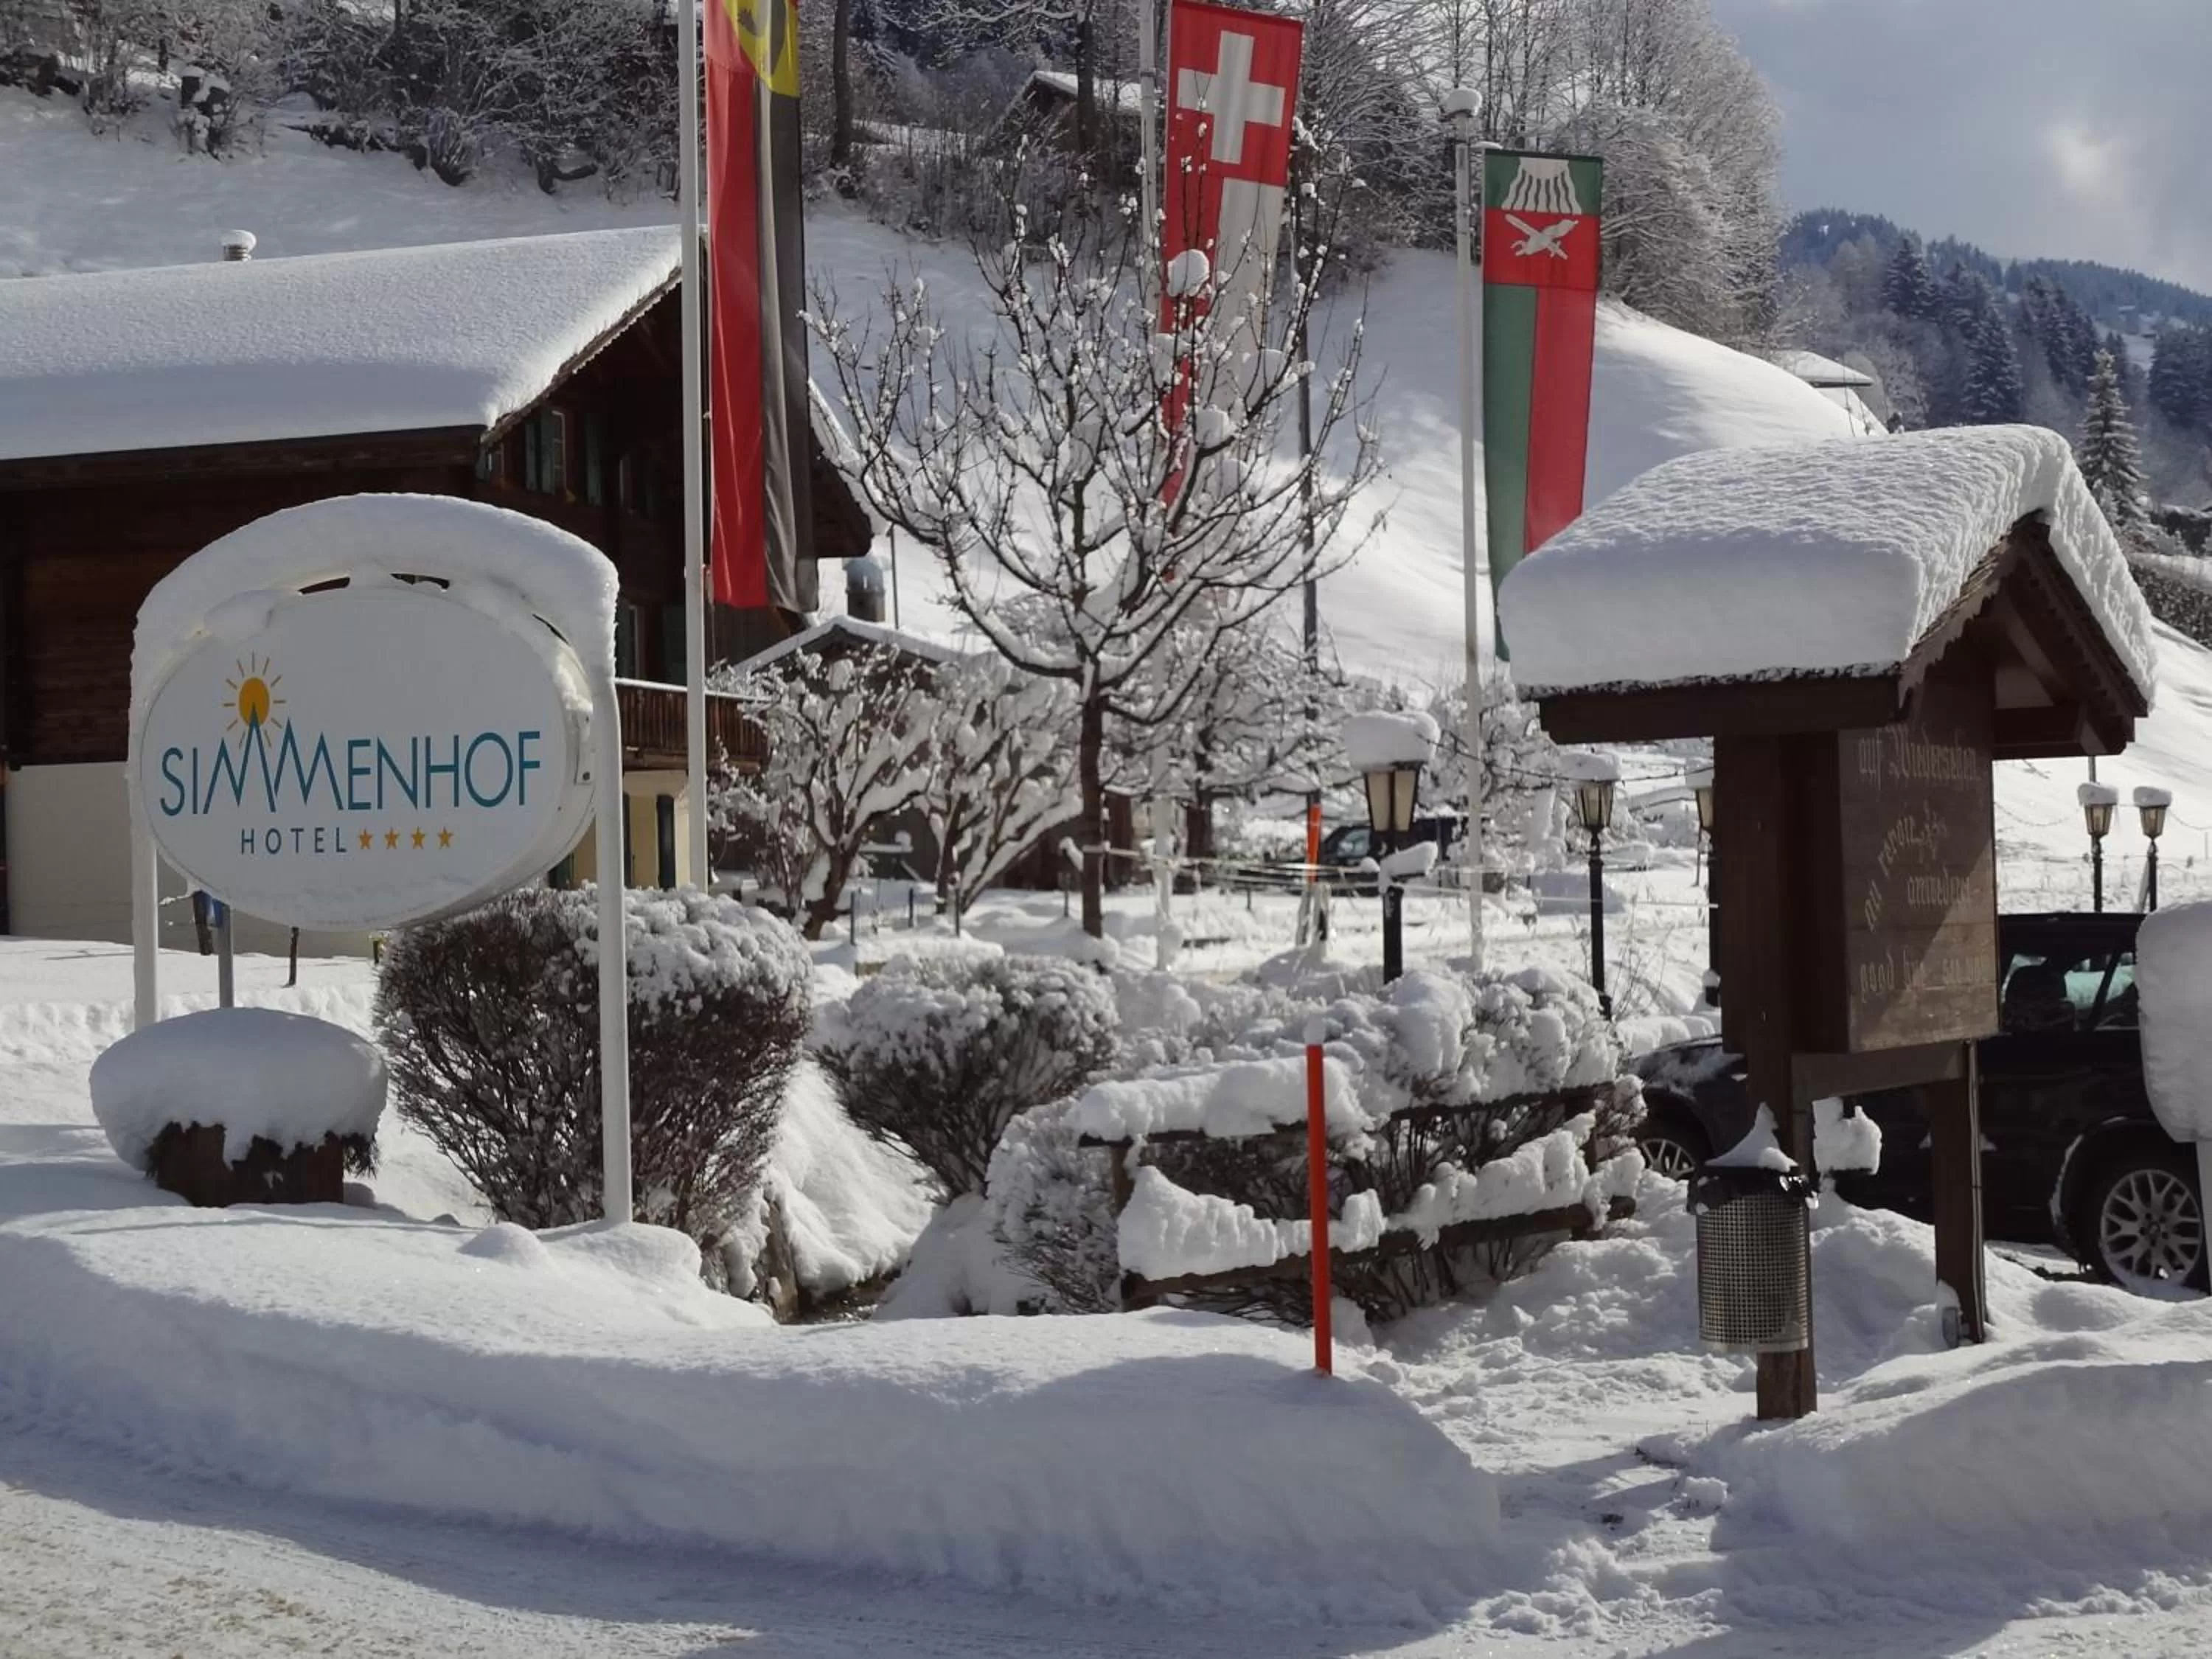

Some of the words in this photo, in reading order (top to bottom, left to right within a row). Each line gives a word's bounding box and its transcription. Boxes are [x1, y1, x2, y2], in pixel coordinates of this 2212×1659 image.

[160, 702, 540, 817] SIMMENHOF
[1857, 726, 1882, 790] auf
[240, 827, 347, 855] HOTEL
